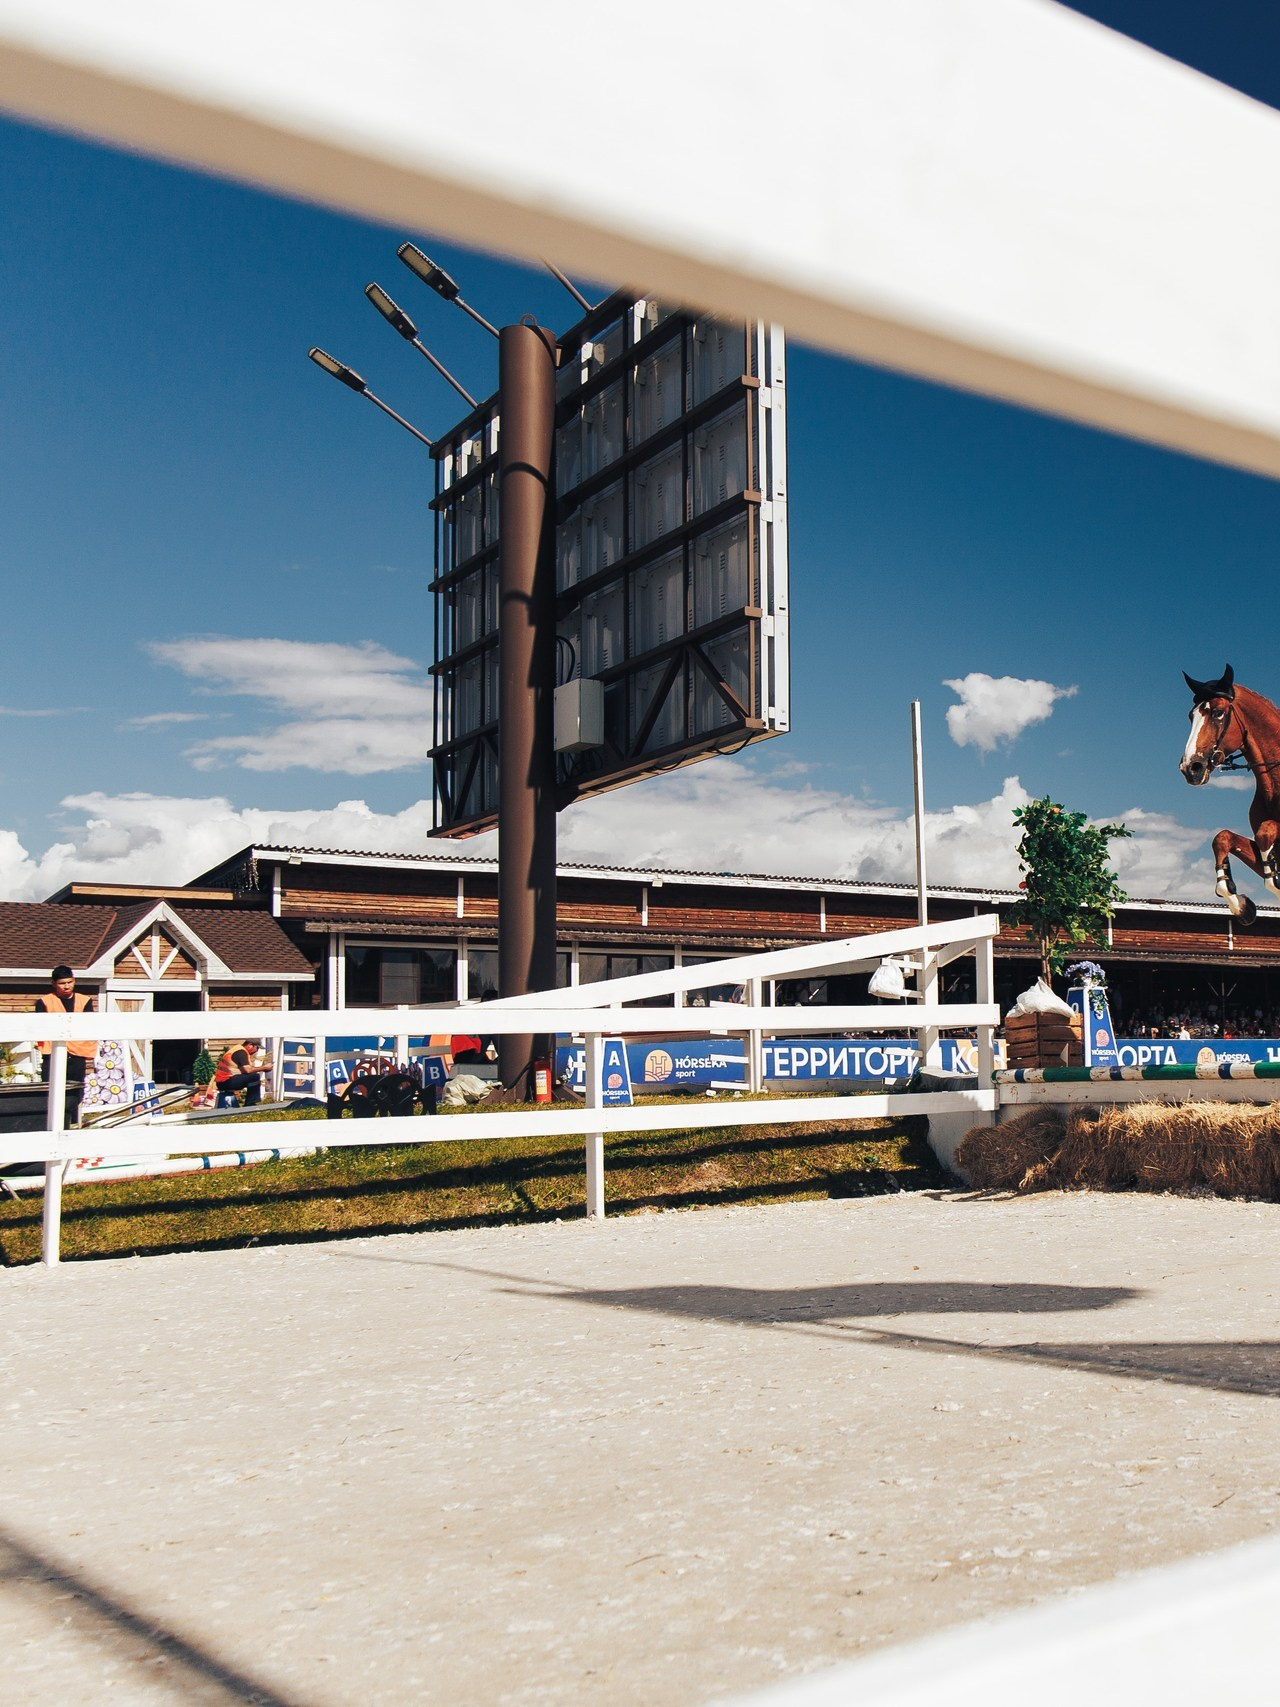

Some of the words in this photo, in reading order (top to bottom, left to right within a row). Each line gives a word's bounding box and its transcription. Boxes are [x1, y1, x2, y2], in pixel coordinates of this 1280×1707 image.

[608, 1050, 621, 1066] A
[332, 1067, 342, 1078] C
[429, 1066, 440, 1079] B
[675, 1070, 696, 1078] sport
